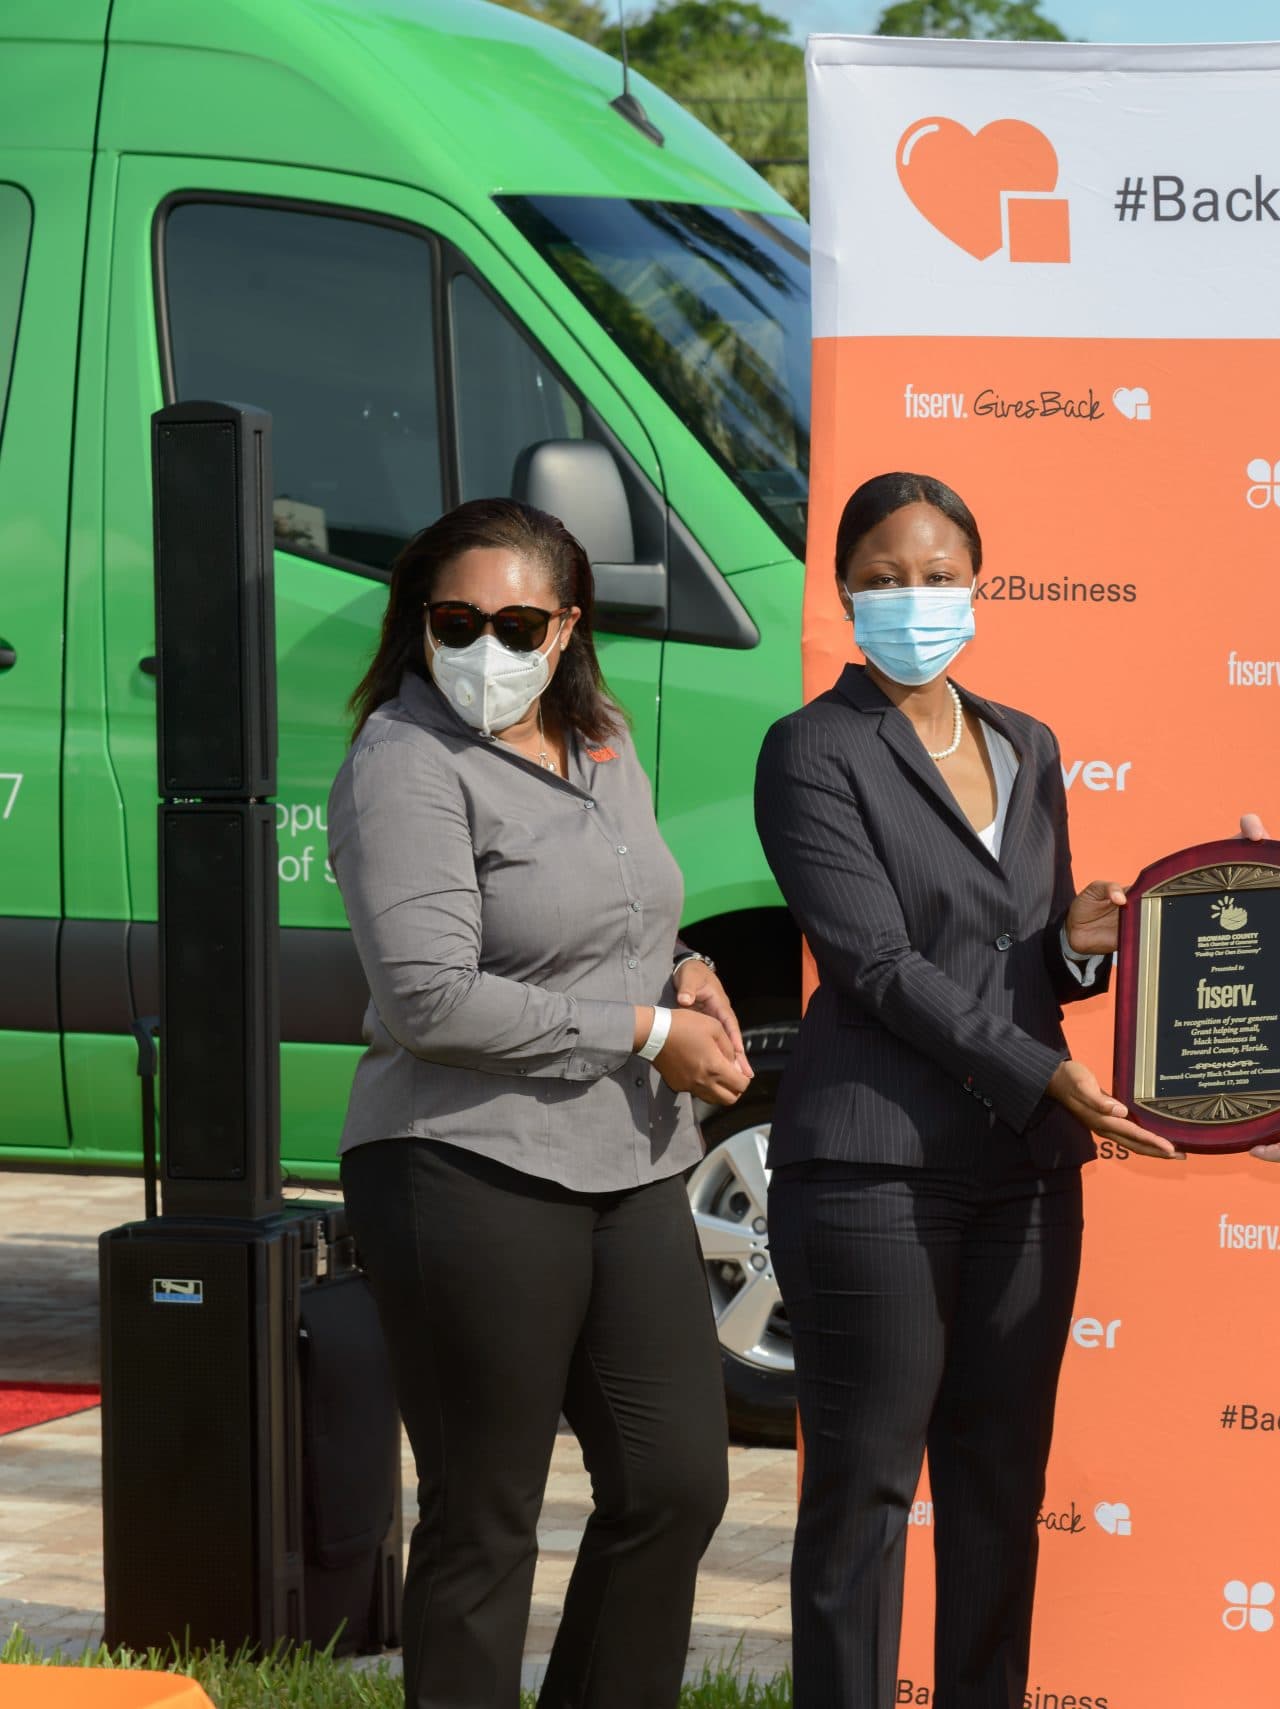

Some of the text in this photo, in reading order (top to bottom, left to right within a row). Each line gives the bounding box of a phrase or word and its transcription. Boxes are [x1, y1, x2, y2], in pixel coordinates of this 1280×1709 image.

[903, 383, 968, 419] fiserv.
[278, 846, 314, 882] of
[1196, 978, 1257, 1010] fiserv.
[1183, 1017, 1221, 1027] recognition
[1212, 1026, 1238, 1036] helping
